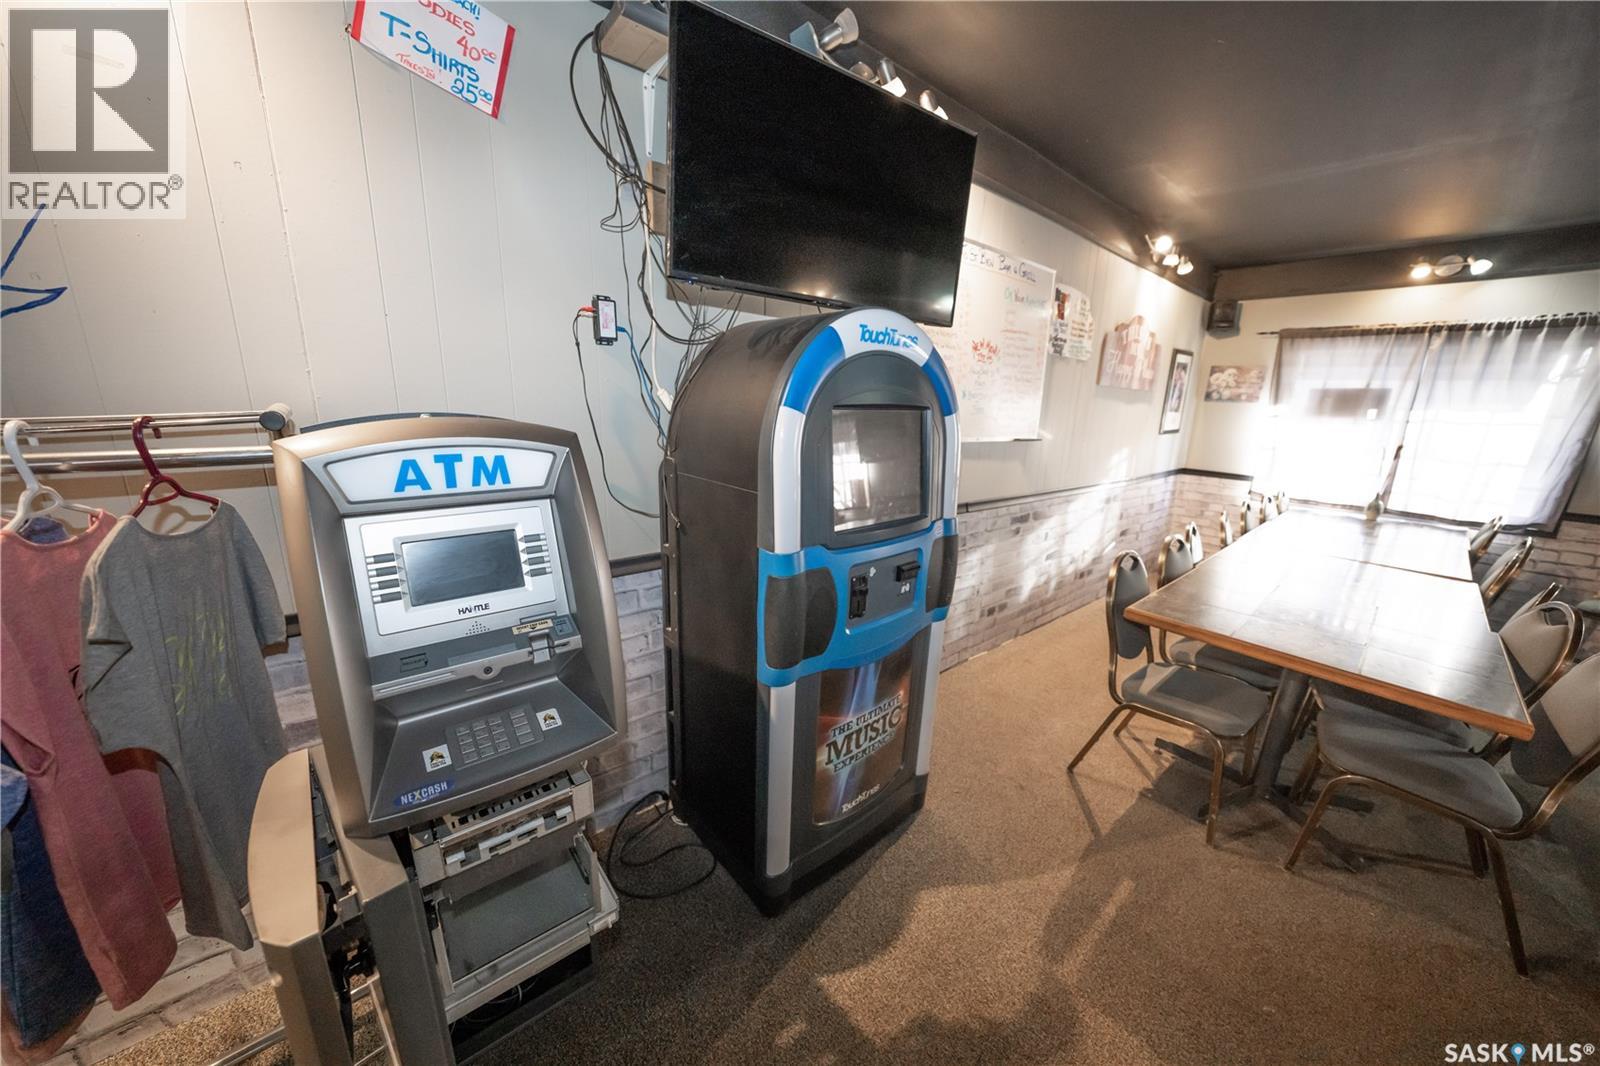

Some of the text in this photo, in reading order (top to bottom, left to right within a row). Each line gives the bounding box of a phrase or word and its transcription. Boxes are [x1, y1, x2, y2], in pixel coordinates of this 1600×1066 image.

[394, 453, 511, 492] ATM
[825, 704, 904, 766] MUSIC
[832, 719, 854, 738] THE
[400, 781, 448, 806] NEXCASH
